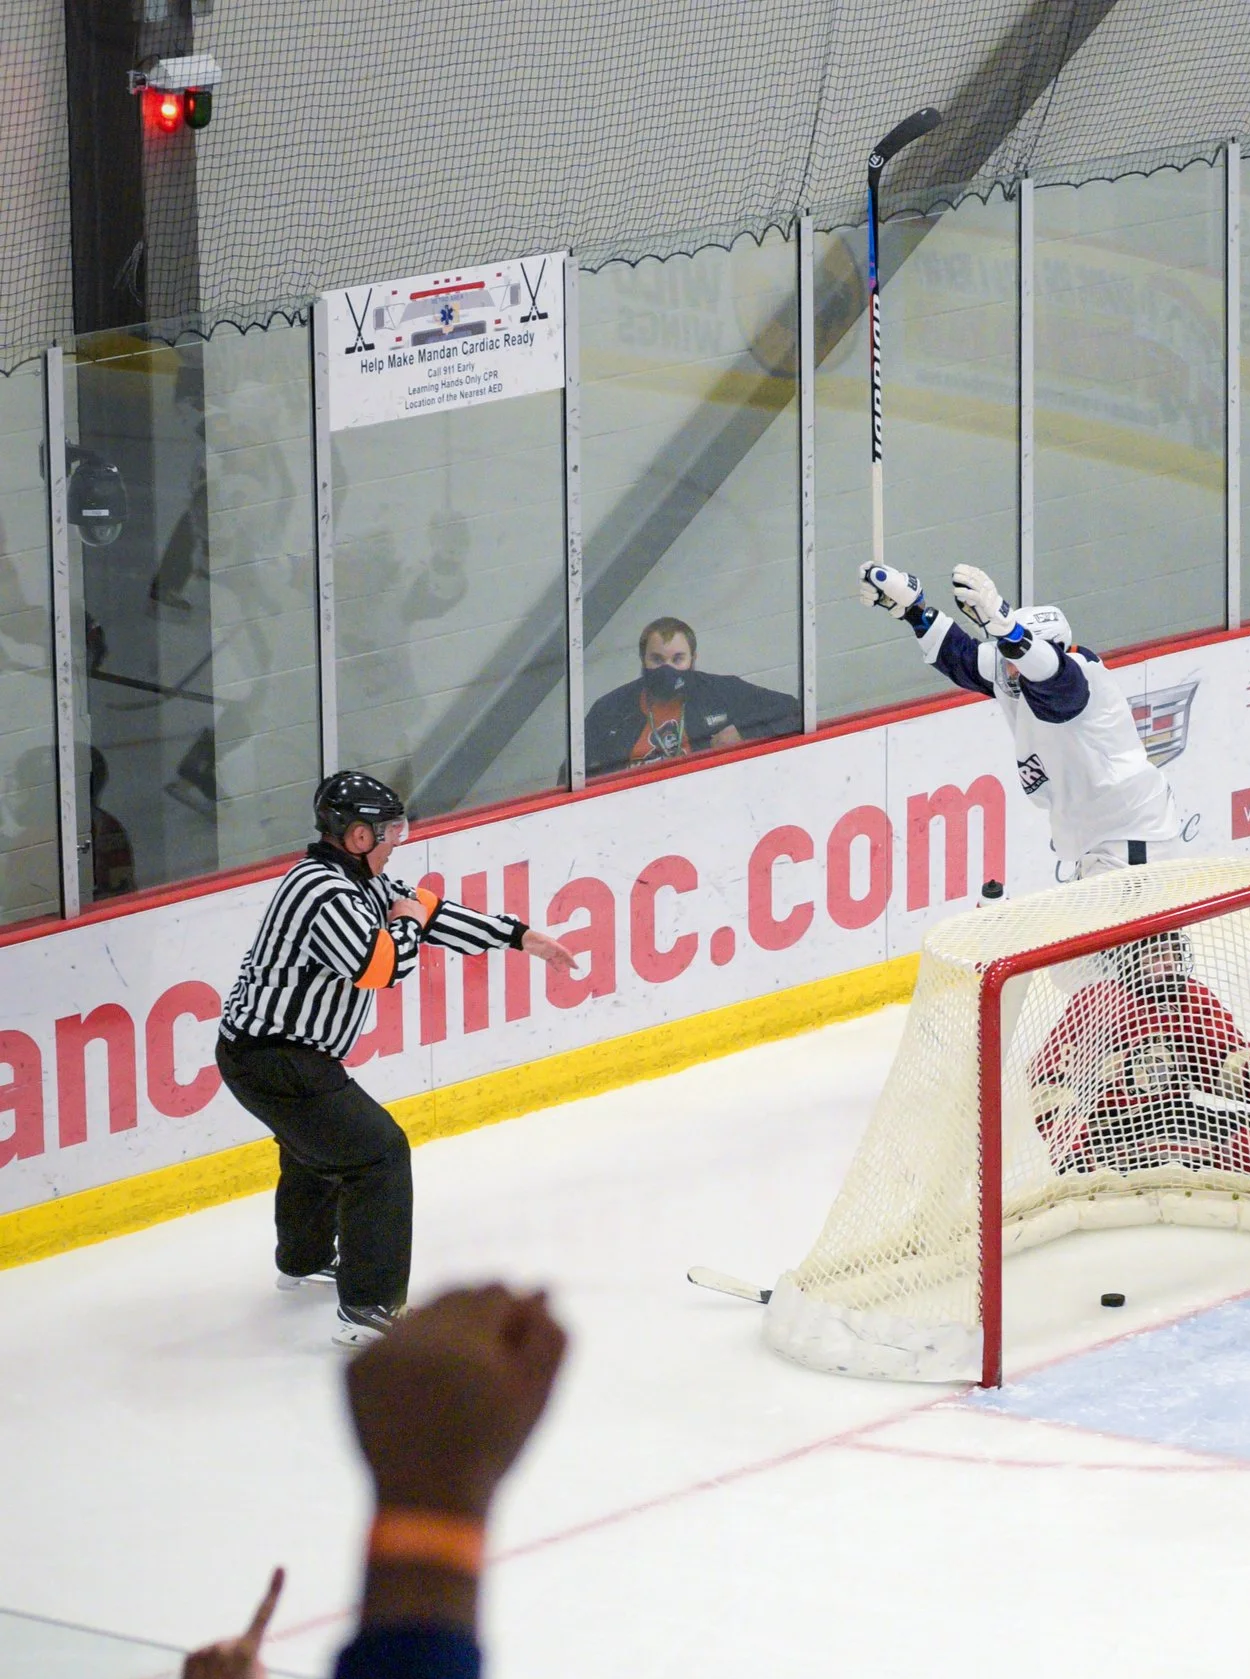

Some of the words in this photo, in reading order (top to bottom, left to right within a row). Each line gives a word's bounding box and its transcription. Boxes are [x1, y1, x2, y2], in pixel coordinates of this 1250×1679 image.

[360, 357, 385, 374] Help
[387, 351, 415, 368] Make
[417, 346, 459, 364] Mandan
[461, 337, 501, 356] Cardiac
[503, 330, 535, 350] Ready
[427, 367, 441, 378] Call
[443, 364, 455, 375] 911
[457, 361, 476, 374] Early
[408, 382, 440, 396] Learning
[441, 378, 464, 390] Hands
[465, 374, 481, 386] Only
[483, 370, 499, 382] CPR
[405, 396, 436, 410] Location
[437, 395, 446, 404] of
[446, 392, 458, 402] the
[459, 386, 487, 400] Nearest
[488, 383, 503, 394] AED
